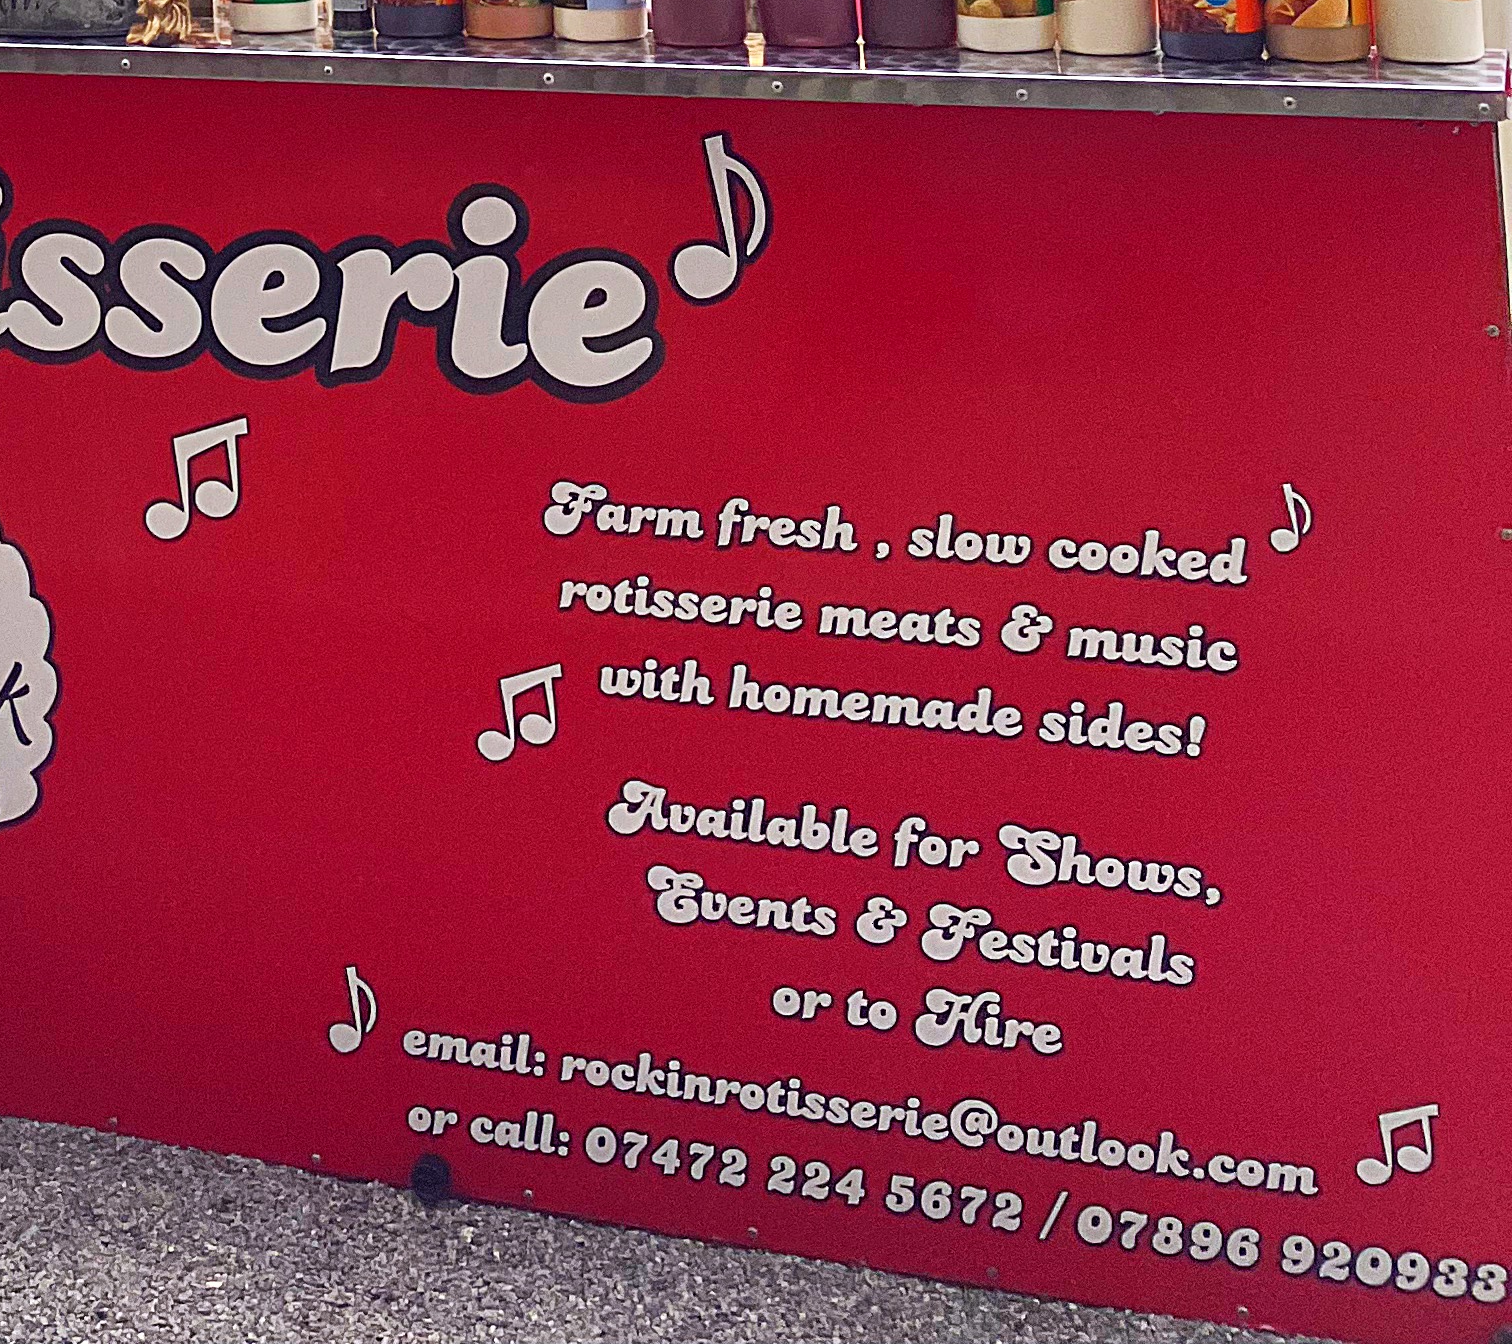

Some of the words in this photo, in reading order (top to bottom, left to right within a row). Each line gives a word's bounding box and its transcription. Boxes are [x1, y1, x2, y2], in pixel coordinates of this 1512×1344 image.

[543, 480, 705, 540] Farm
[717, 497, 858, 555] fresh
[907, 513, 1032, 566] slow
[1047, 529, 1249, 586] cooked
[558, 576, 803, 632] rotisserie
[818, 602, 982, 650] meats
[999, 603, 1054, 653] &
[1066, 623, 1239, 674] music
[598, 657, 715, 707] with
[727, 663, 1023, 740] homemade
[1037, 699, 1207, 759] sides!
[608, 779, 879, 859] Available
[893, 816, 981, 869] for
[998, 823, 1224, 907] Shows,
[645, 864, 837, 937] Events
[855, 895, 907, 945] &
[919, 902, 1195, 986] Festivals
[771, 985, 832, 1021] or
[846, 988, 899, 1032] to
[914, 987, 1065, 1055] Hire
[402, 1027, 547, 1077] email:
[560, 1052, 1319, 1196] rockinrotisserie@outlook.com
[407, 1105, 458, 1136] or
[469, 1110, 571, 1157] call:
[584, 1125, 749, 1189] 07472
[765, 1154, 867, 1206] 224
[885, 1173, 1023, 1233] 5672
[1075, 1204, 1261, 1269] 07896
[1280, 1234, 1509, 1305] 920933
